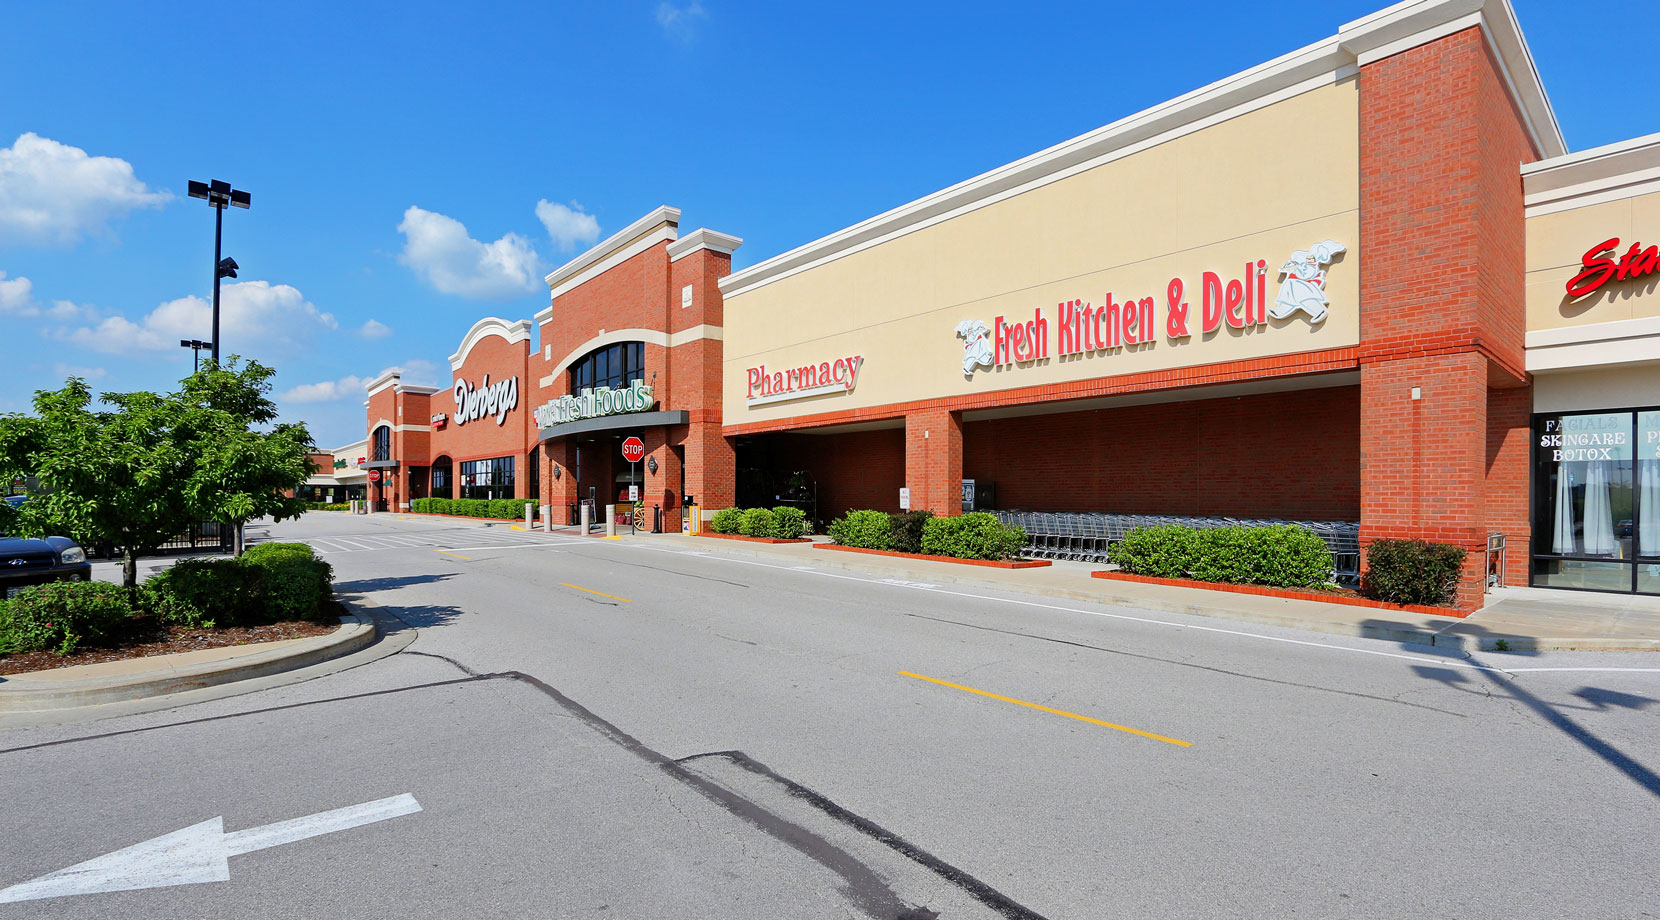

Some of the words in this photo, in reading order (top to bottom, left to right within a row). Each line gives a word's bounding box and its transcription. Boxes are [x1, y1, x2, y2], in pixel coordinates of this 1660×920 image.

[994, 307, 1049, 366] Fresh
[1057, 292, 1156, 355] Kitchen
[1166, 277, 1190, 338] &
[1202, 259, 1267, 333] Deli
[746, 354, 862, 399] Pharmacy
[454, 374, 517, 425] Dierbergs
[559, 387, 594, 422] Fresh
[594, 379, 649, 416] Foods
[1545, 416, 1619, 432] FACIALS
[624, 444, 643, 455] STOP
[1540, 431, 1626, 448] SKINCARE
[1552, 447, 1613, 462] BOTOX
